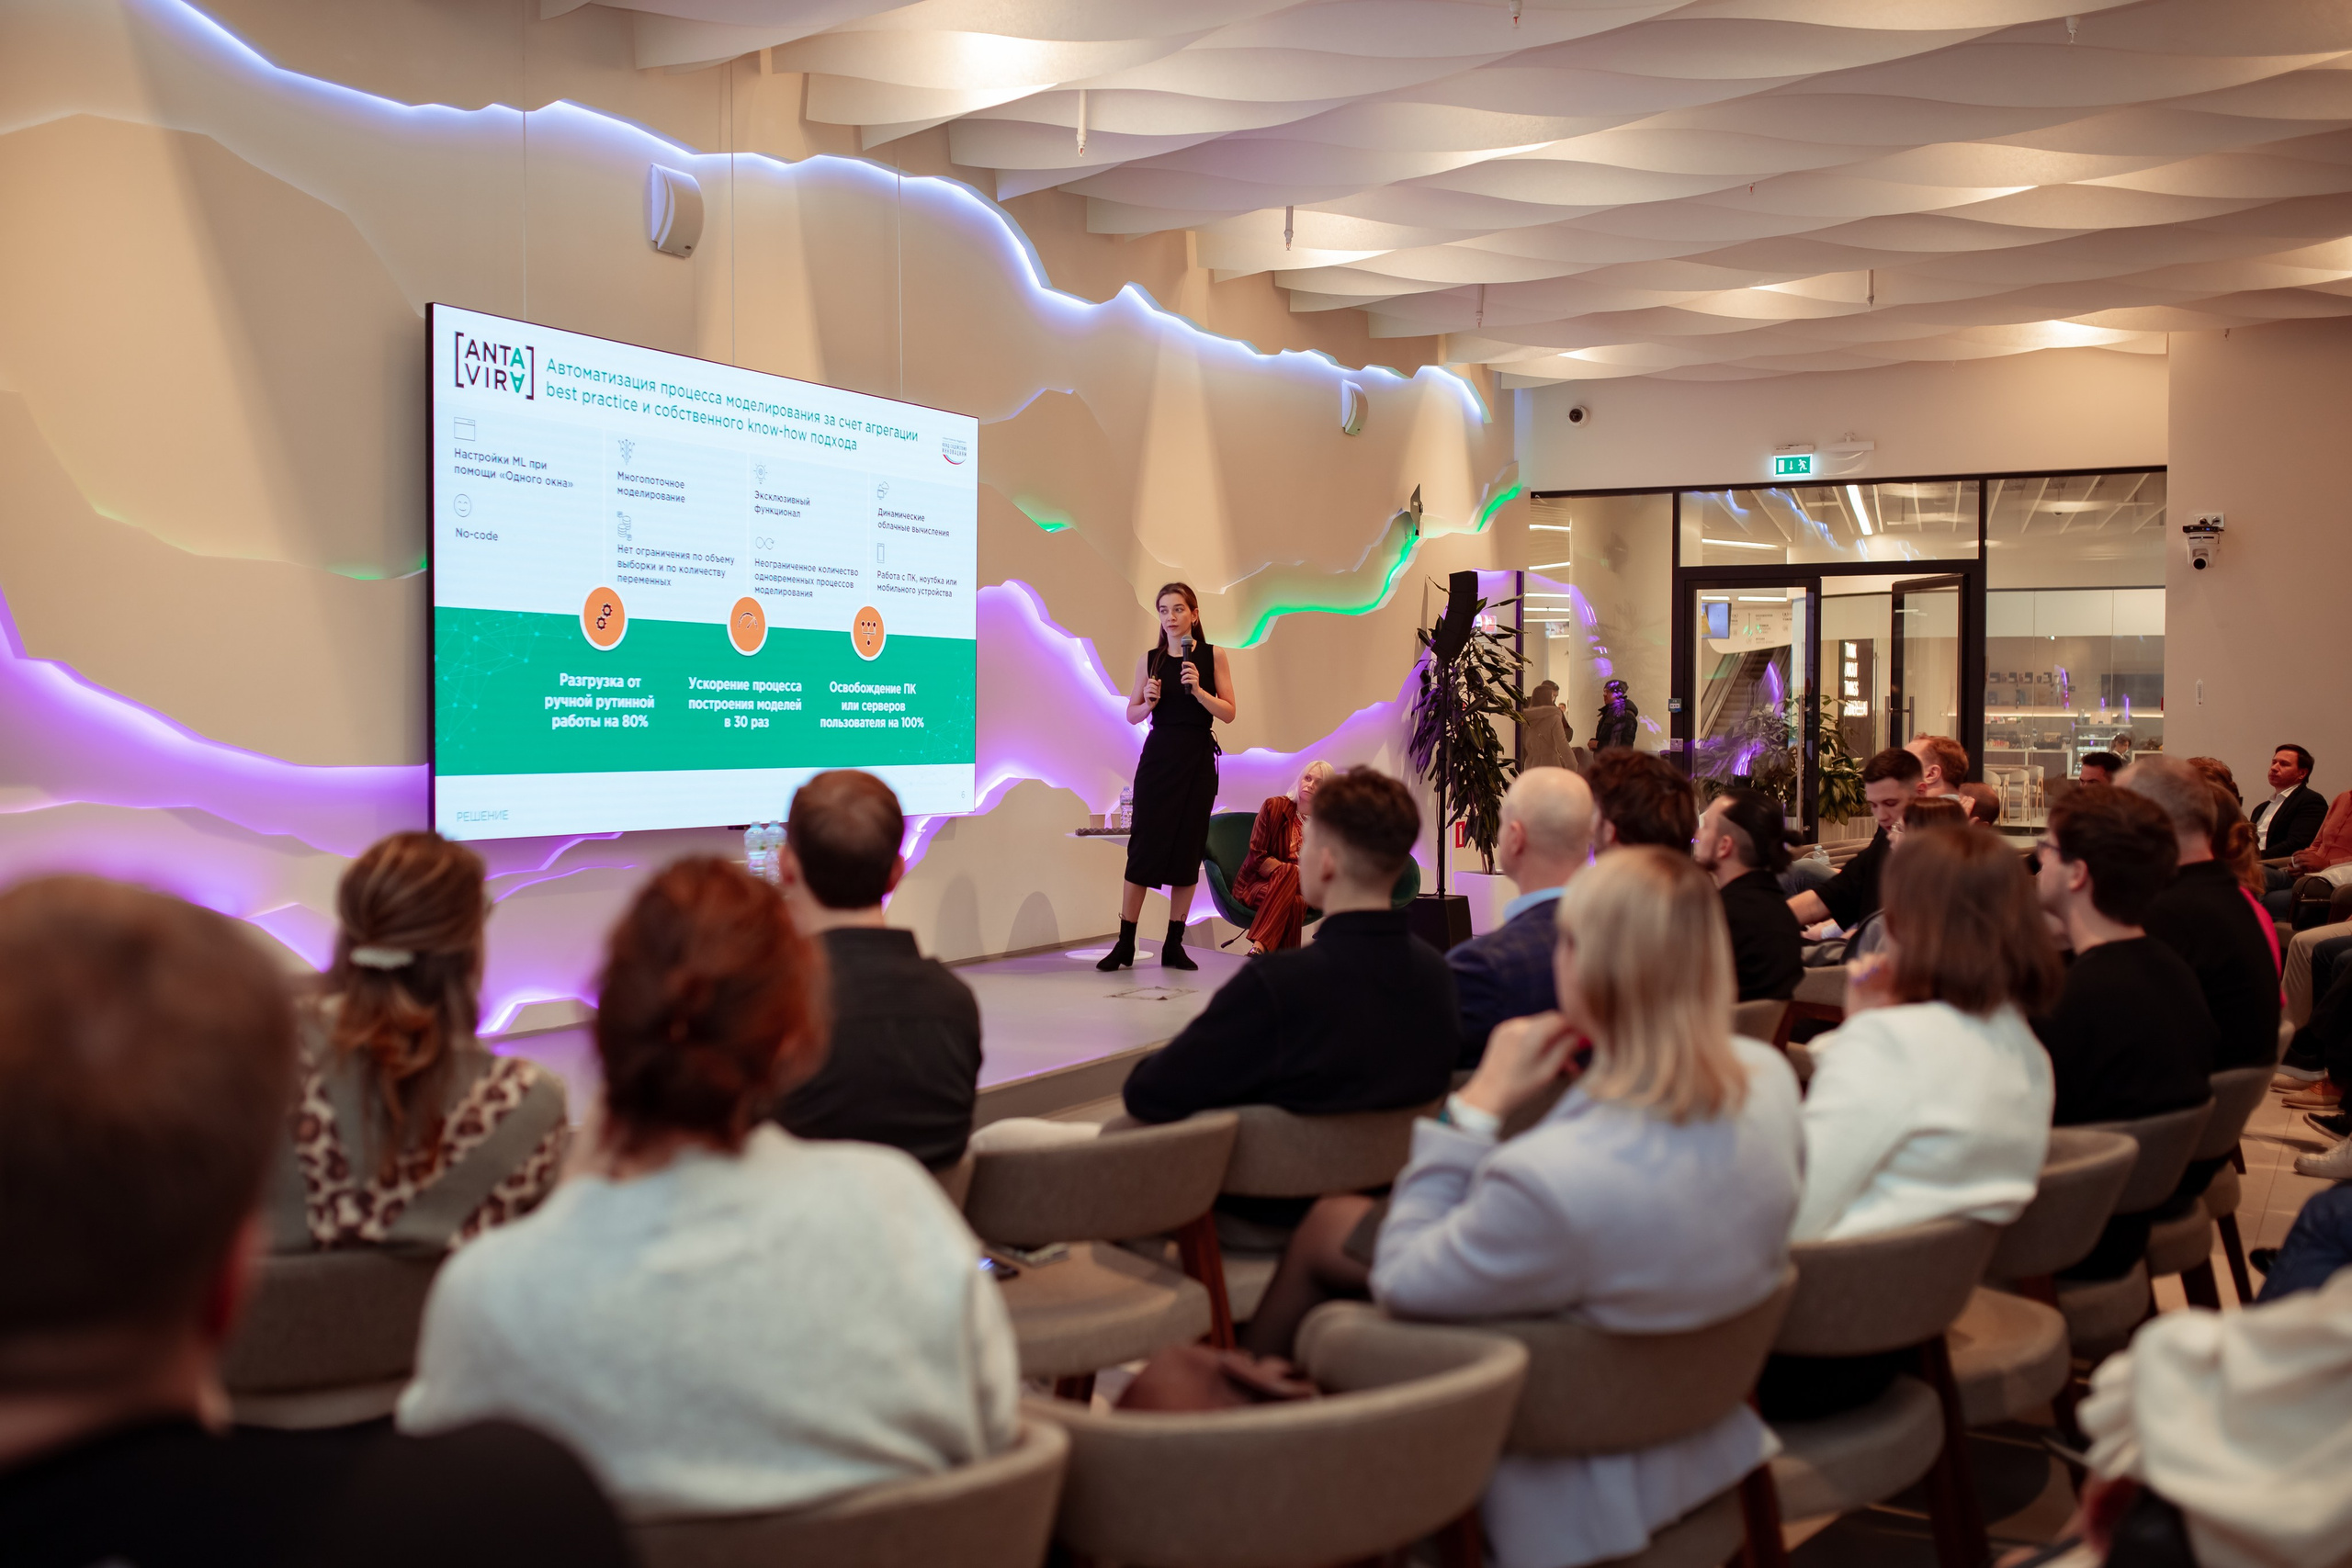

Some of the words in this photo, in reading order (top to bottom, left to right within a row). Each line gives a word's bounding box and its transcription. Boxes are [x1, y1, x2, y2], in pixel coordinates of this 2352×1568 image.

[465, 339, 526, 369] ANTA
[547, 358, 656, 392] Автоматизация
[661, 382, 722, 405] процесса
[726, 395, 820, 423] моделирования
[824, 415, 836, 426] за
[838, 419, 862, 432] счет
[865, 423, 919, 442] агрегации
[547, 380, 578, 401] best
[582, 389, 639, 412] practice
[642, 402, 650, 414] и
[654, 402, 744, 430] собственного
[748, 418, 807, 441] know-how
[810, 432, 857, 451] подхода
[454, 447, 510, 465] Настройки
[512, 456, 526, 467] ML
[529, 459, 548, 469] при
[454, 465, 496, 478] помощи
[617, 470, 685, 489] Многопоточное
[617, 487, 686, 502] моделирование
[754, 490, 811, 505] Эксклюзивный
[877, 508, 925, 521] Динамические
[455, 527, 499, 541] No-code
[877, 521, 910, 532] облачные
[911, 525, 950, 536] вычисления
[617, 544, 633, 554] Нет
[635, 547, 691, 560] ограничения
[705, 553, 735, 565] объему
[617, 559, 656, 570] выборки
[666, 564, 677, 572] по
[679, 566, 727, 578] количеству
[754, 558, 817, 571] Неограниченное
[818, 565, 860, 576] количество
[617, 573, 672, 586] переменных
[754, 573, 815, 584] одновременных
[816, 578, 855, 588] процессов
[876, 570, 900, 580] Работа
[754, 587, 814, 597] моделирования
[876, 584, 916, 594] мобильного
[917, 587, 953, 597] устройства
[559, 672, 625, 689] Разгрузка
[627, 677, 642, 687] от
[688, 676, 750, 692] Ускорение
[752, 681, 803, 693] процесса
[829, 681, 902, 694] Освобождение
[903, 682, 917, 694] ПК
[544, 694, 594, 709] ручной
[595, 694, 655, 709] рутинной
[688, 699, 754, 711] построения
[756, 698, 802, 711] моделей
[841, 702, 860, 710] или
[861, 702, 907, 713] серверов
[551, 714, 602, 729] работы
[604, 716, 620, 727] на
[621, 714, 650, 727] 80%
[724, 717, 731, 727] в
[733, 716, 749, 727] 30
[751, 717, 770, 729] раз
[820, 718, 887, 728] пользователя
[888, 718, 899, 728] на
[900, 716, 924, 728] 100%
[456, 809, 509, 822] РЕШЕНИЕ
